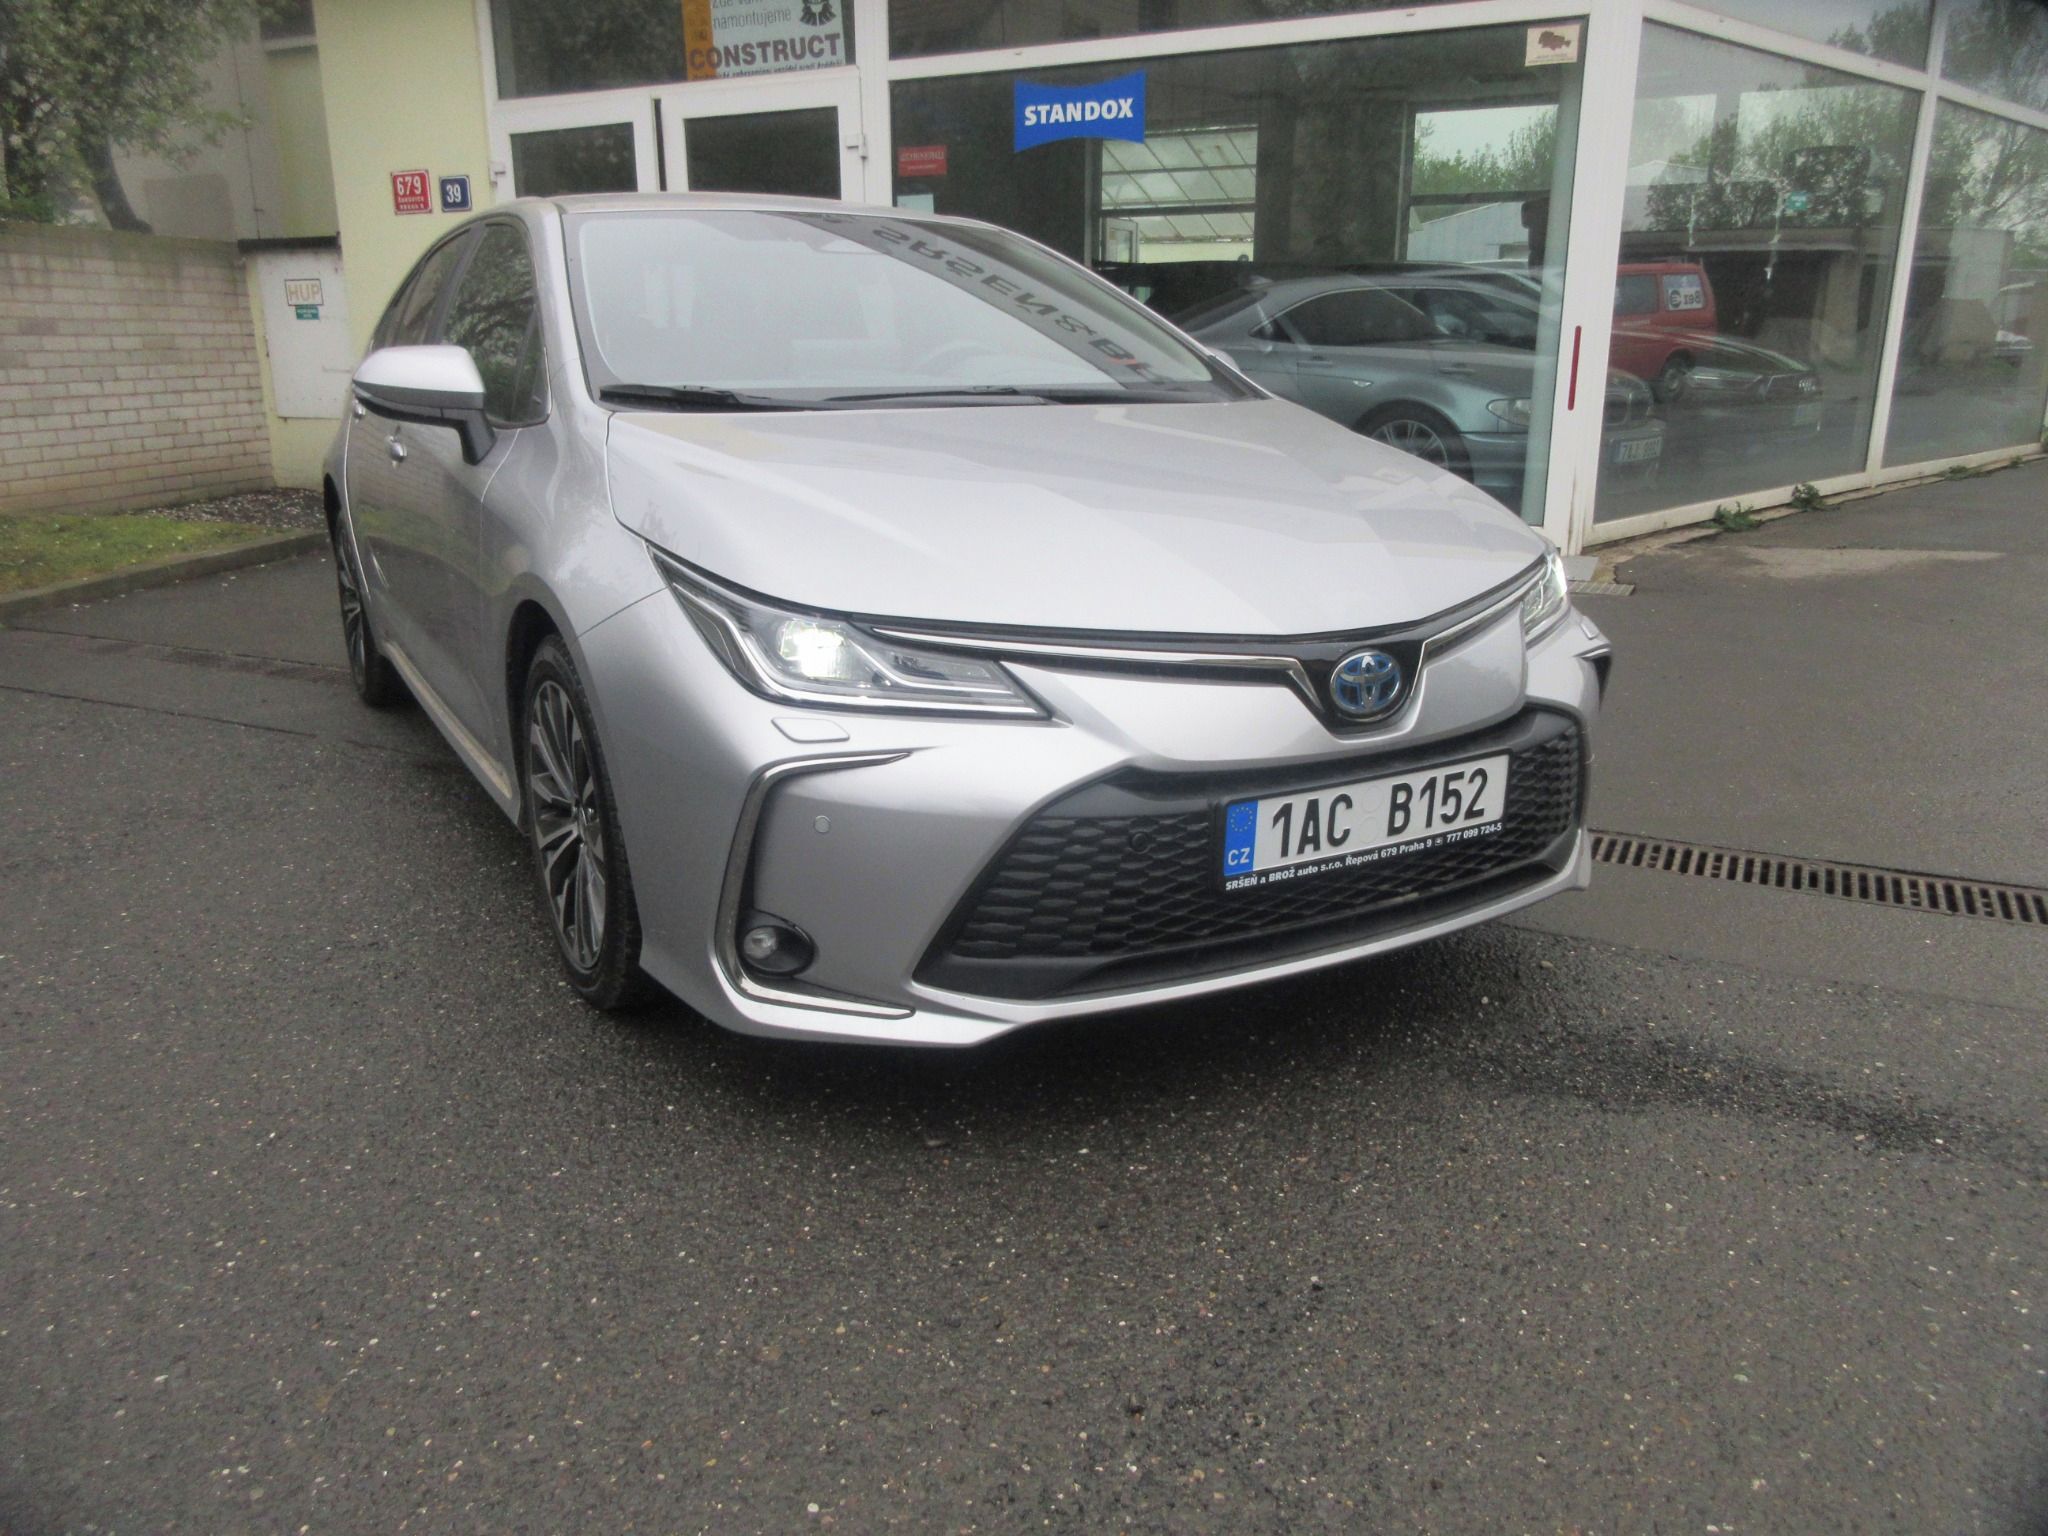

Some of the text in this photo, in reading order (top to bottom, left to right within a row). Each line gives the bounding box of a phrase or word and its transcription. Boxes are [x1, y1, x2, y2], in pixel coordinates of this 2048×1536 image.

[713, 7, 792, 31] namontujeme
[688, 32, 841, 71] CONSTRUCT
[1024, 97, 1134, 127] STANDOX
[396, 175, 422, 196] 679
[446, 183, 462, 203] 39
[1272, 767, 1489, 858] 1AC B152
[1225, 874, 1258, 891] SRŠEŇ
[1268, 867, 1296, 882] BROŽ
[1297, 865, 1319, 877] auto
[1320, 861, 1343, 871] s.r.o.
[1345, 850, 1379, 866] Řepová
[1381, 846, 1397, 858] 679
[1400, 842, 1425, 854] Praha
[1427, 839, 1432, 848] 9
[1446, 832, 1461, 843] 777
[1463, 828, 1479, 839] 099
[1480, 822, 1502, 835] 724-5
[1227, 847, 1251, 866] CZ
